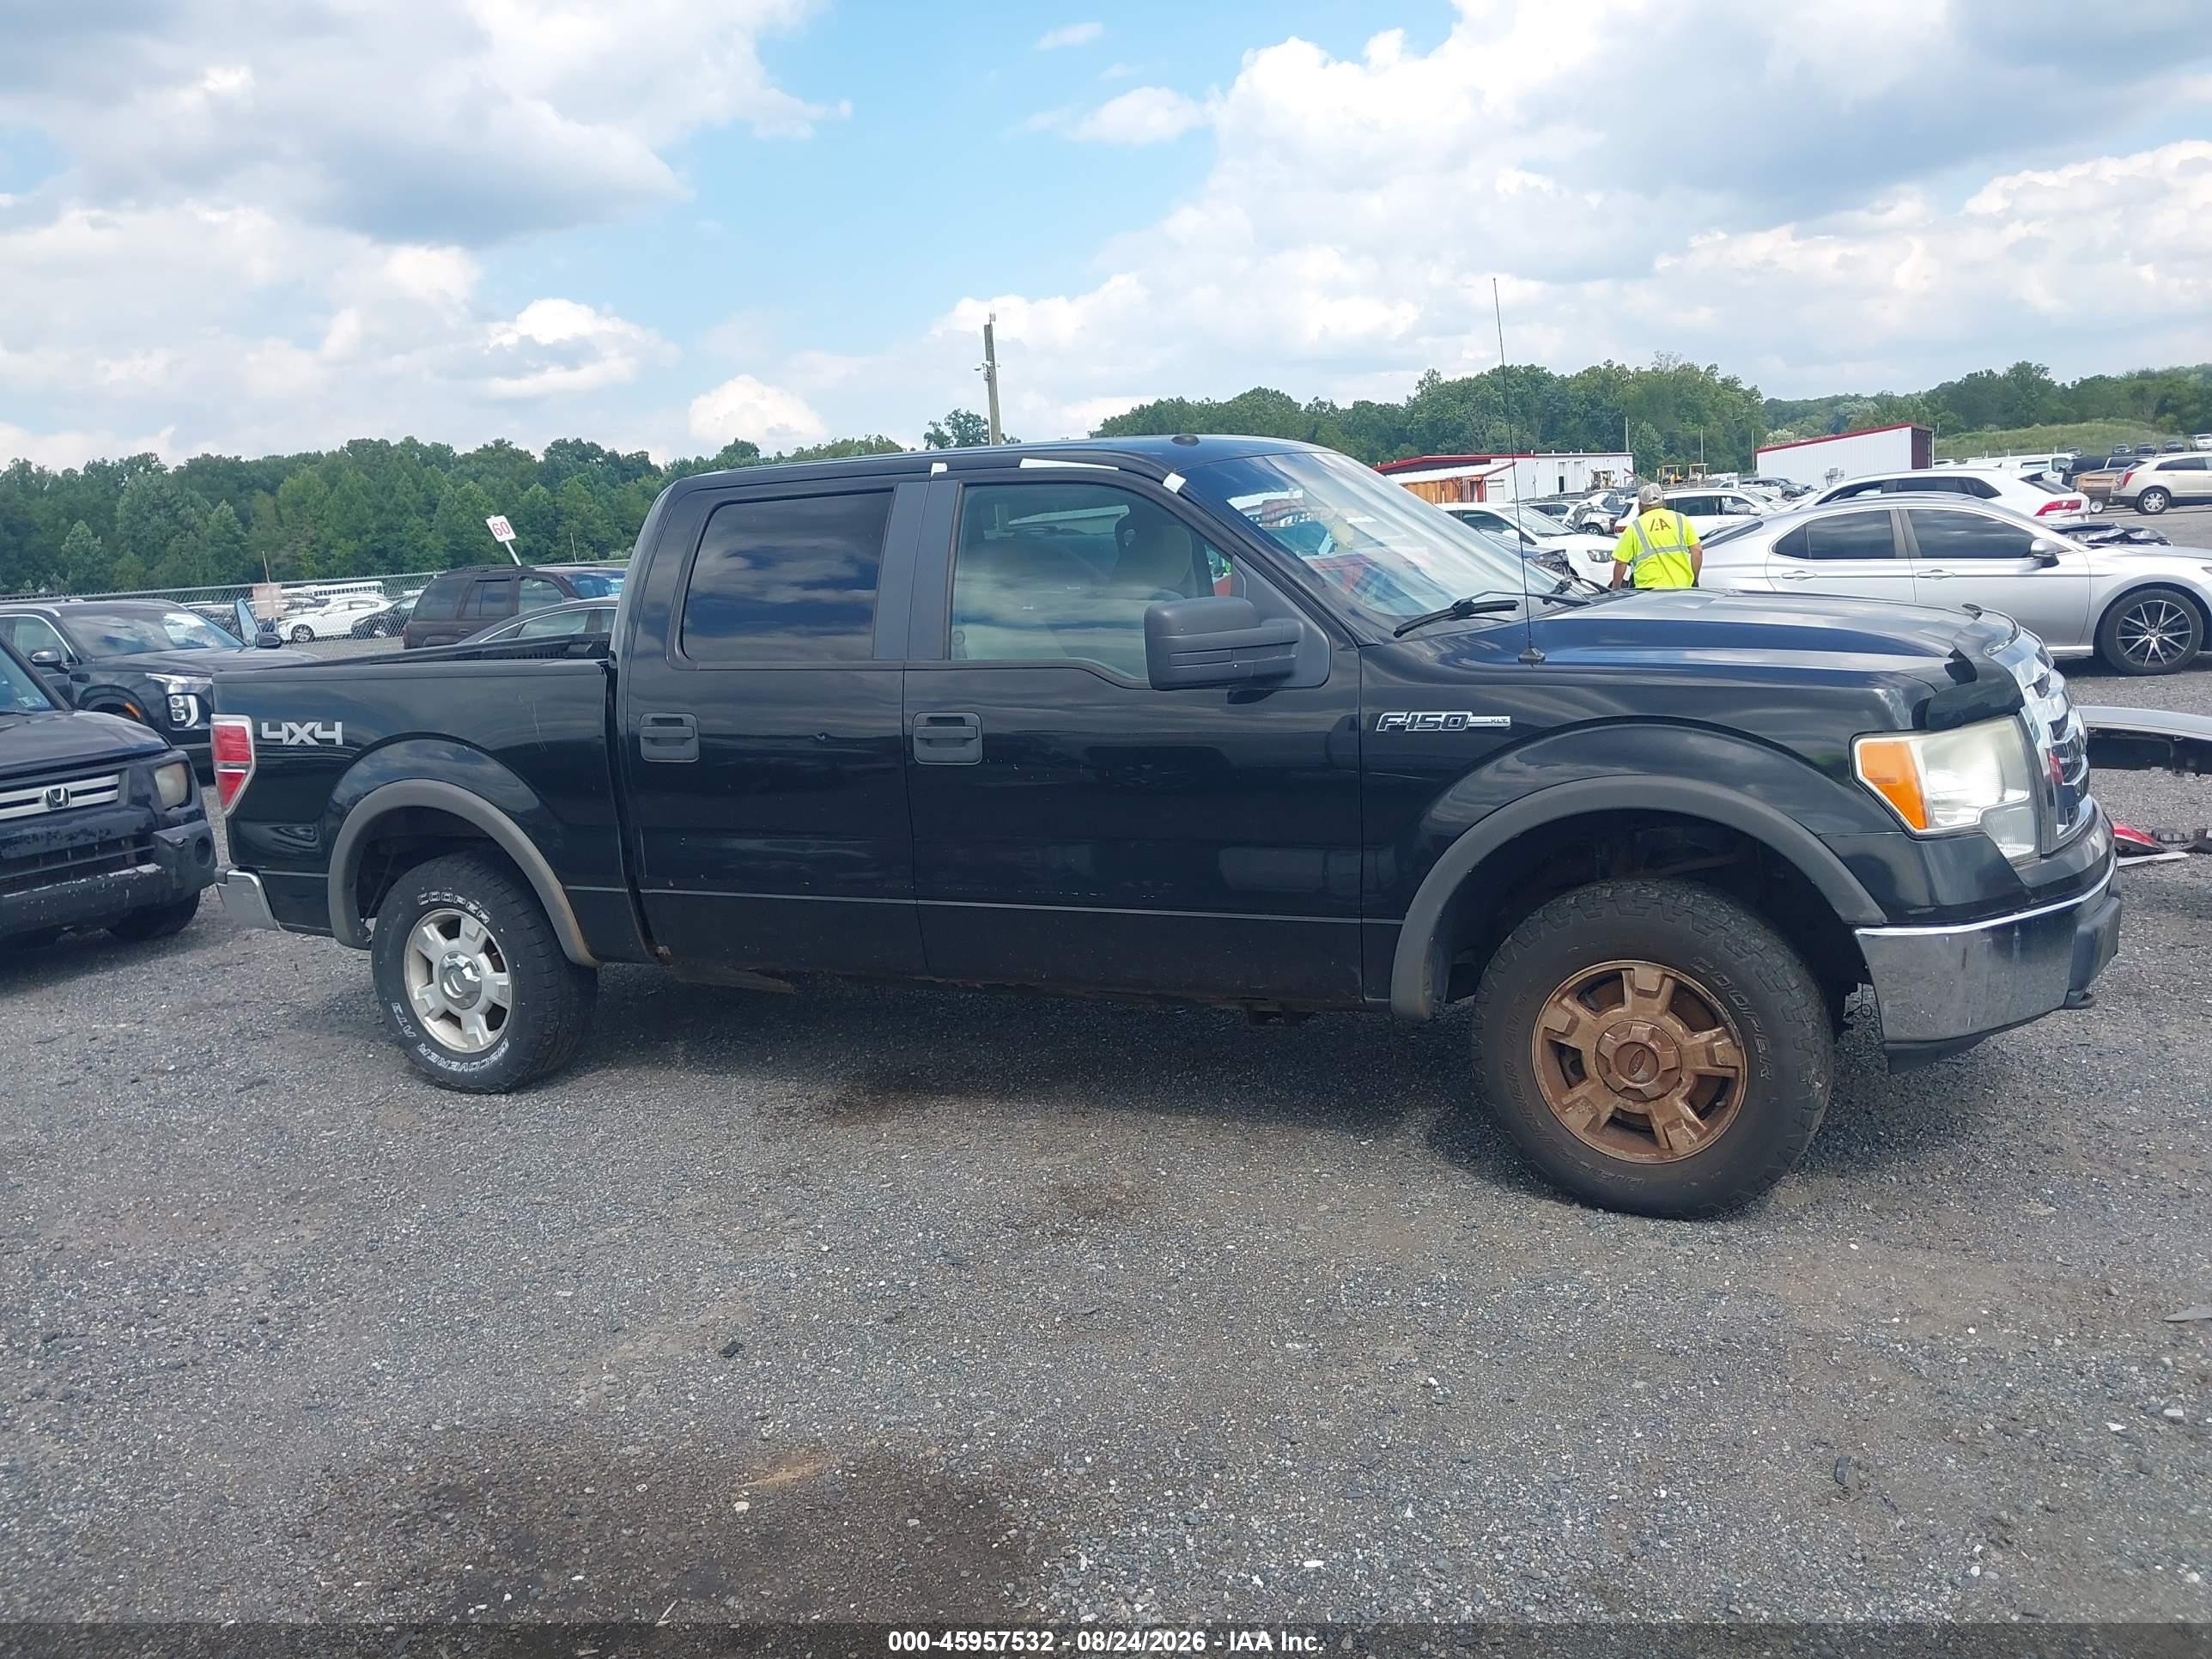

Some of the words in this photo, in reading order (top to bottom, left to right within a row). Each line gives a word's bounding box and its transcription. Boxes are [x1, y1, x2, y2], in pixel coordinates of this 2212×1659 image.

[492, 521, 511, 537] 60
[1376, 711, 1474, 732] F-150
[417, 890, 490, 925] COOPER
[1690, 957, 1773, 1080] COOPER
[417, 1037, 510, 1073] DISCOVERER
